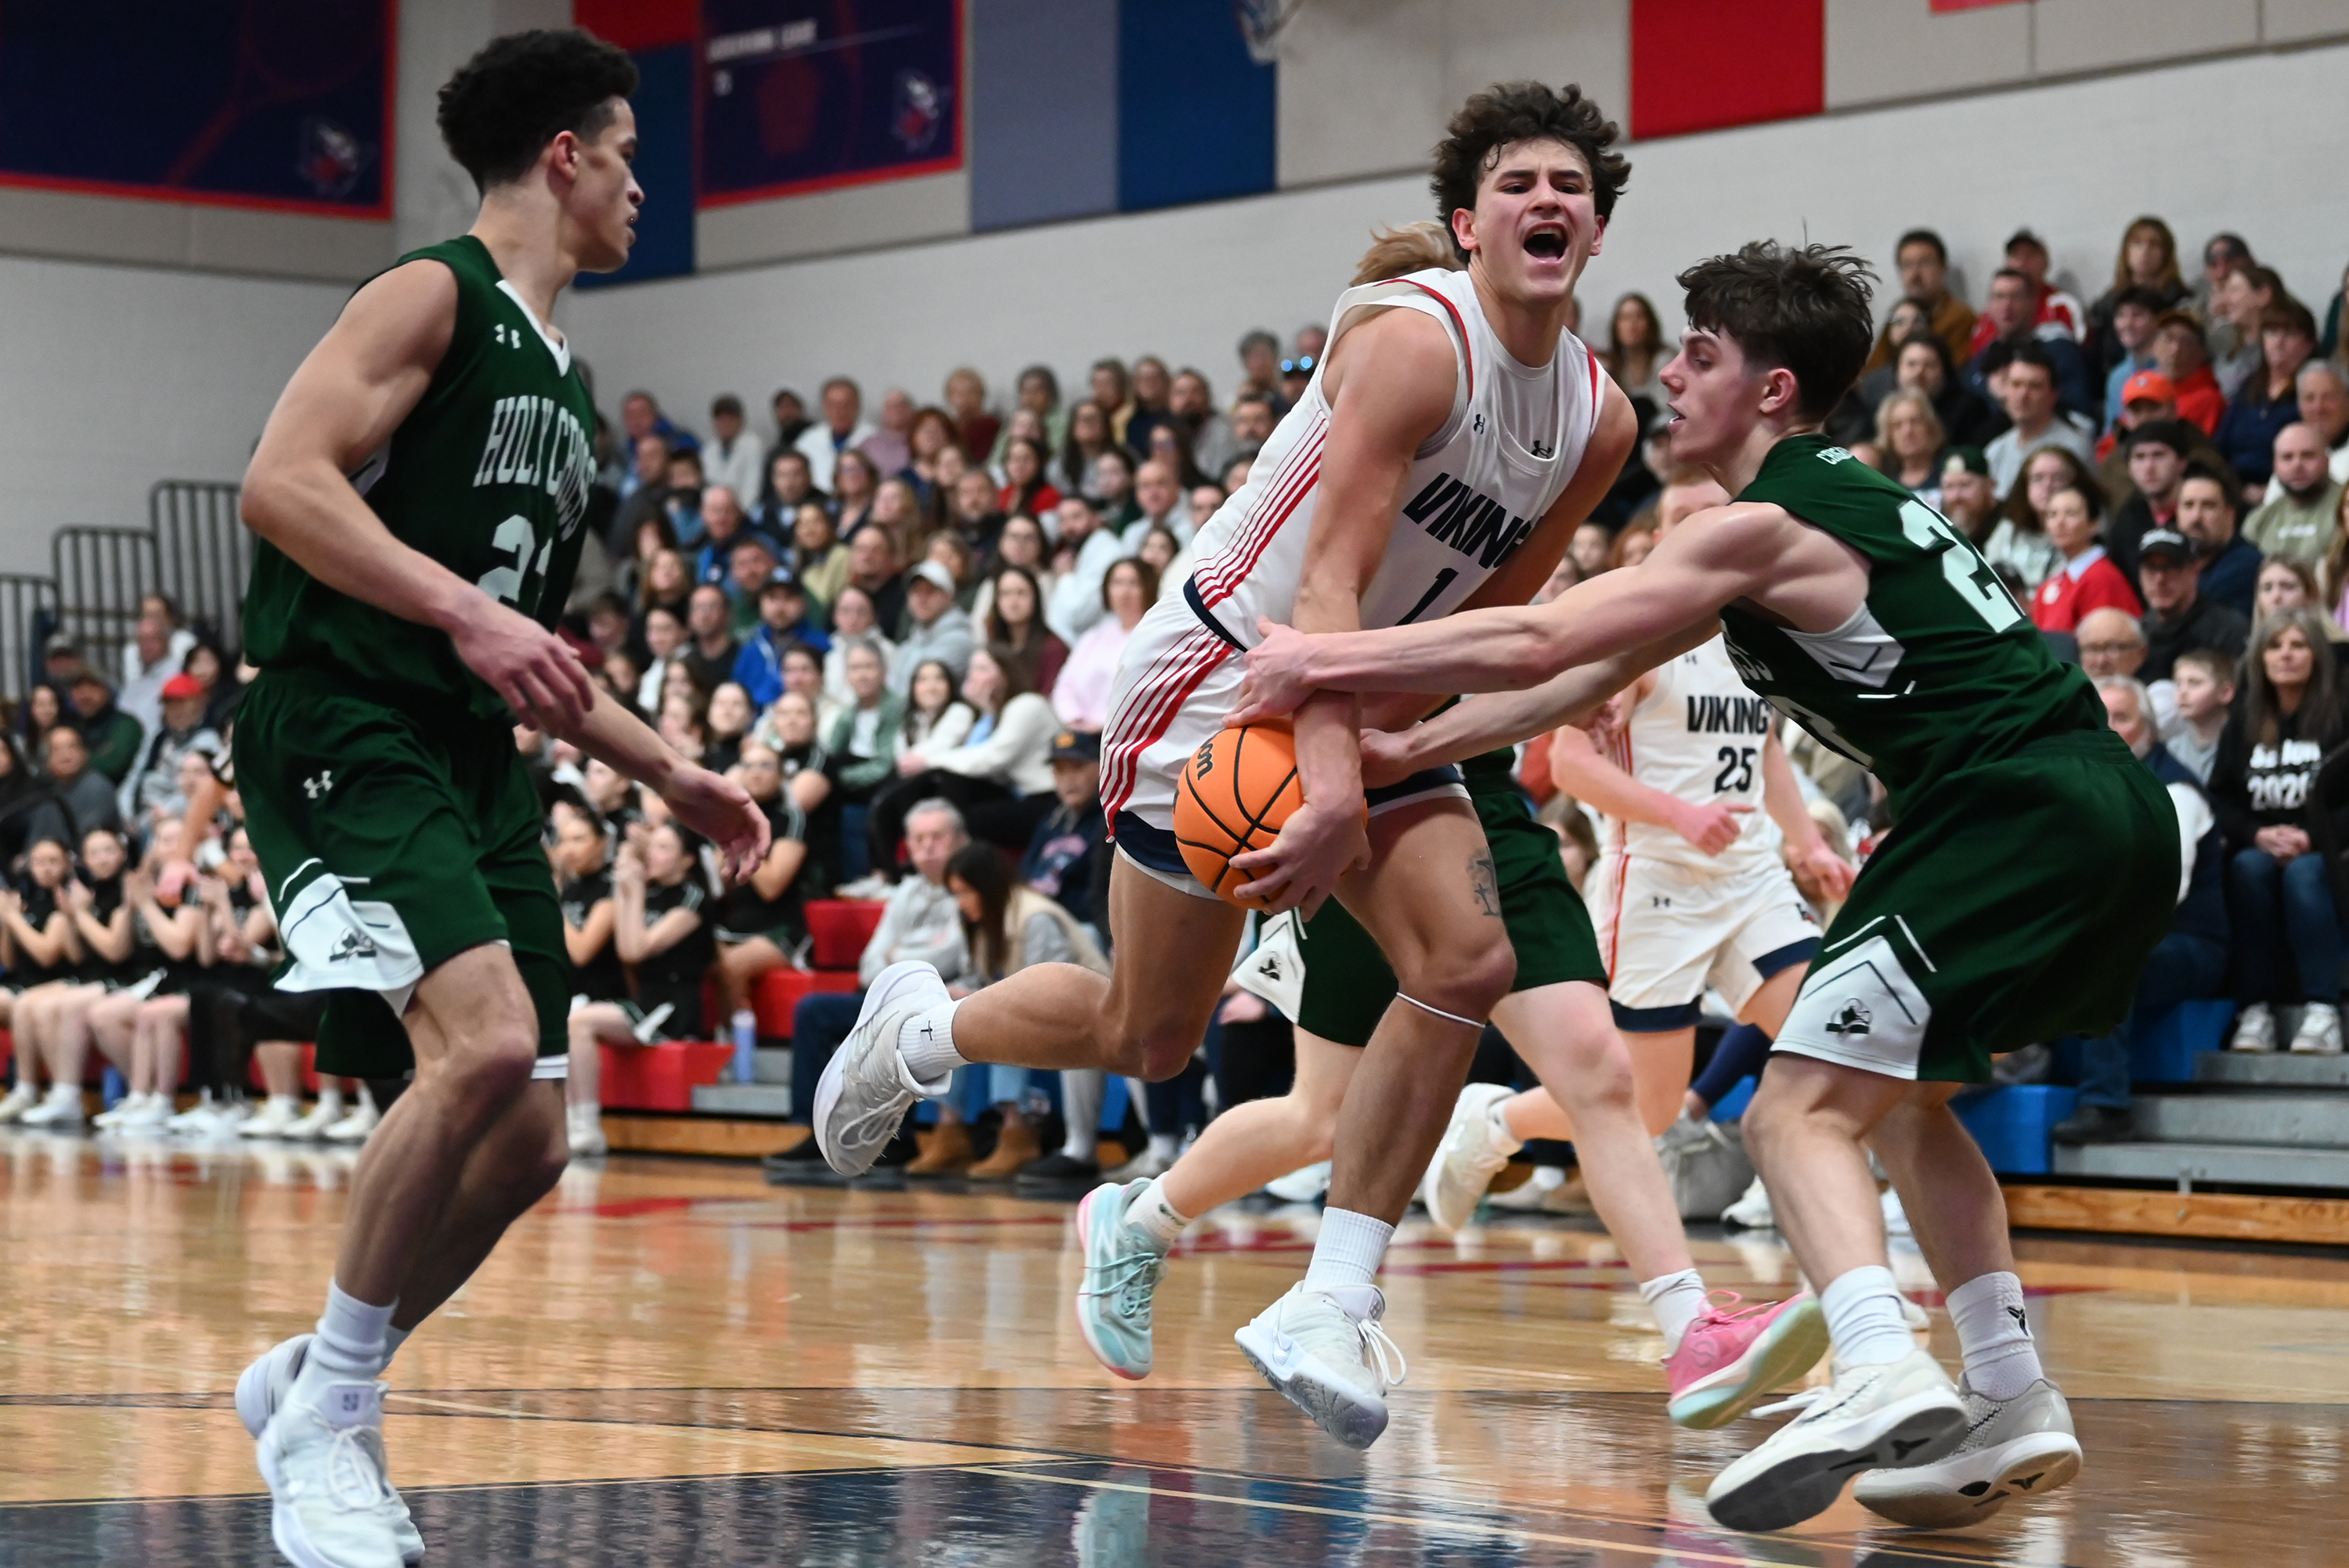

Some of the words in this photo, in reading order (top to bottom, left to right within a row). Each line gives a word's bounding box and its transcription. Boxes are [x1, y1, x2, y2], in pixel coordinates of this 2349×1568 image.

[472, 395, 554, 488] HOLY
[1402, 472, 1545, 570] VIKING
[1395, 568, 1459, 626] 1
[1687, 694, 1773, 734] VIKING
[1196, 739, 1214, 781] on
[1714, 746, 1758, 794] 25
